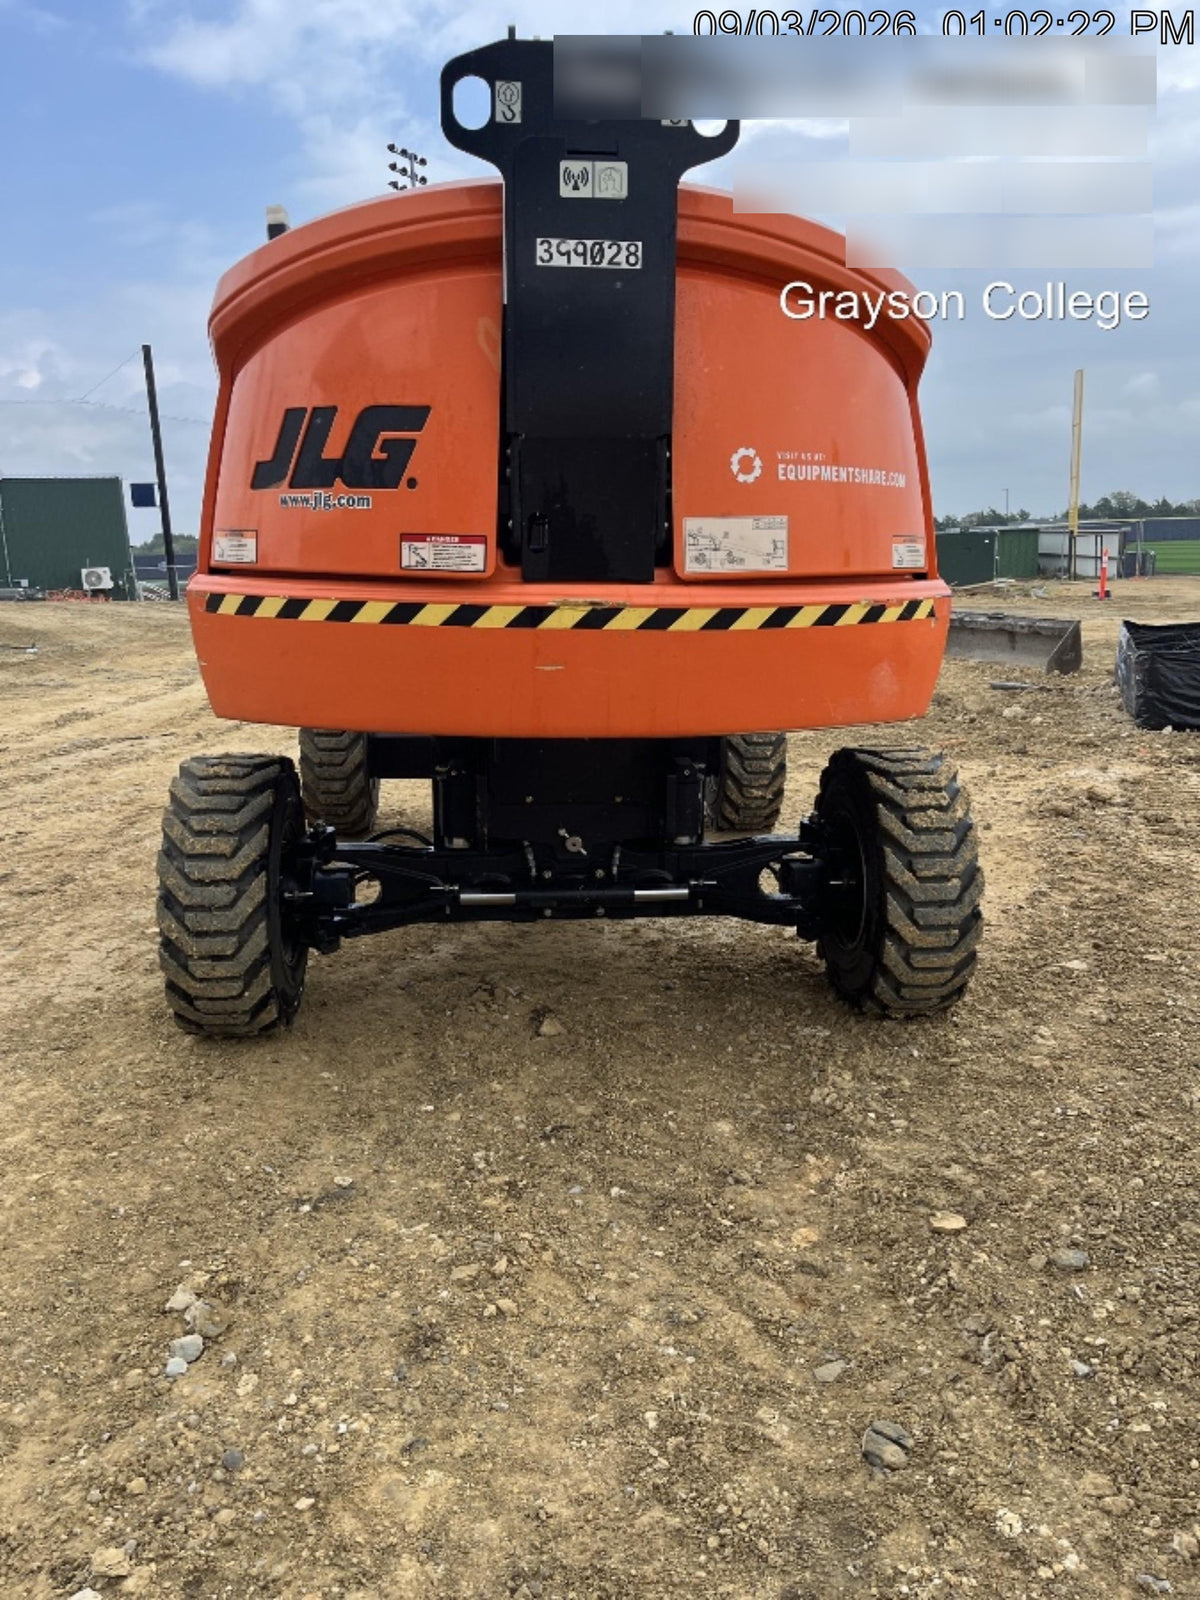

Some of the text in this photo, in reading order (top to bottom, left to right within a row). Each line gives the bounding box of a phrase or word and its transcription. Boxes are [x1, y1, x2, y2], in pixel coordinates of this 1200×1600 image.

[539, 240, 639, 267] 399028
[777, 463, 906, 488] EQUIPMENTSHARE.COM
[280, 491, 371, 511] www.jlg.com
